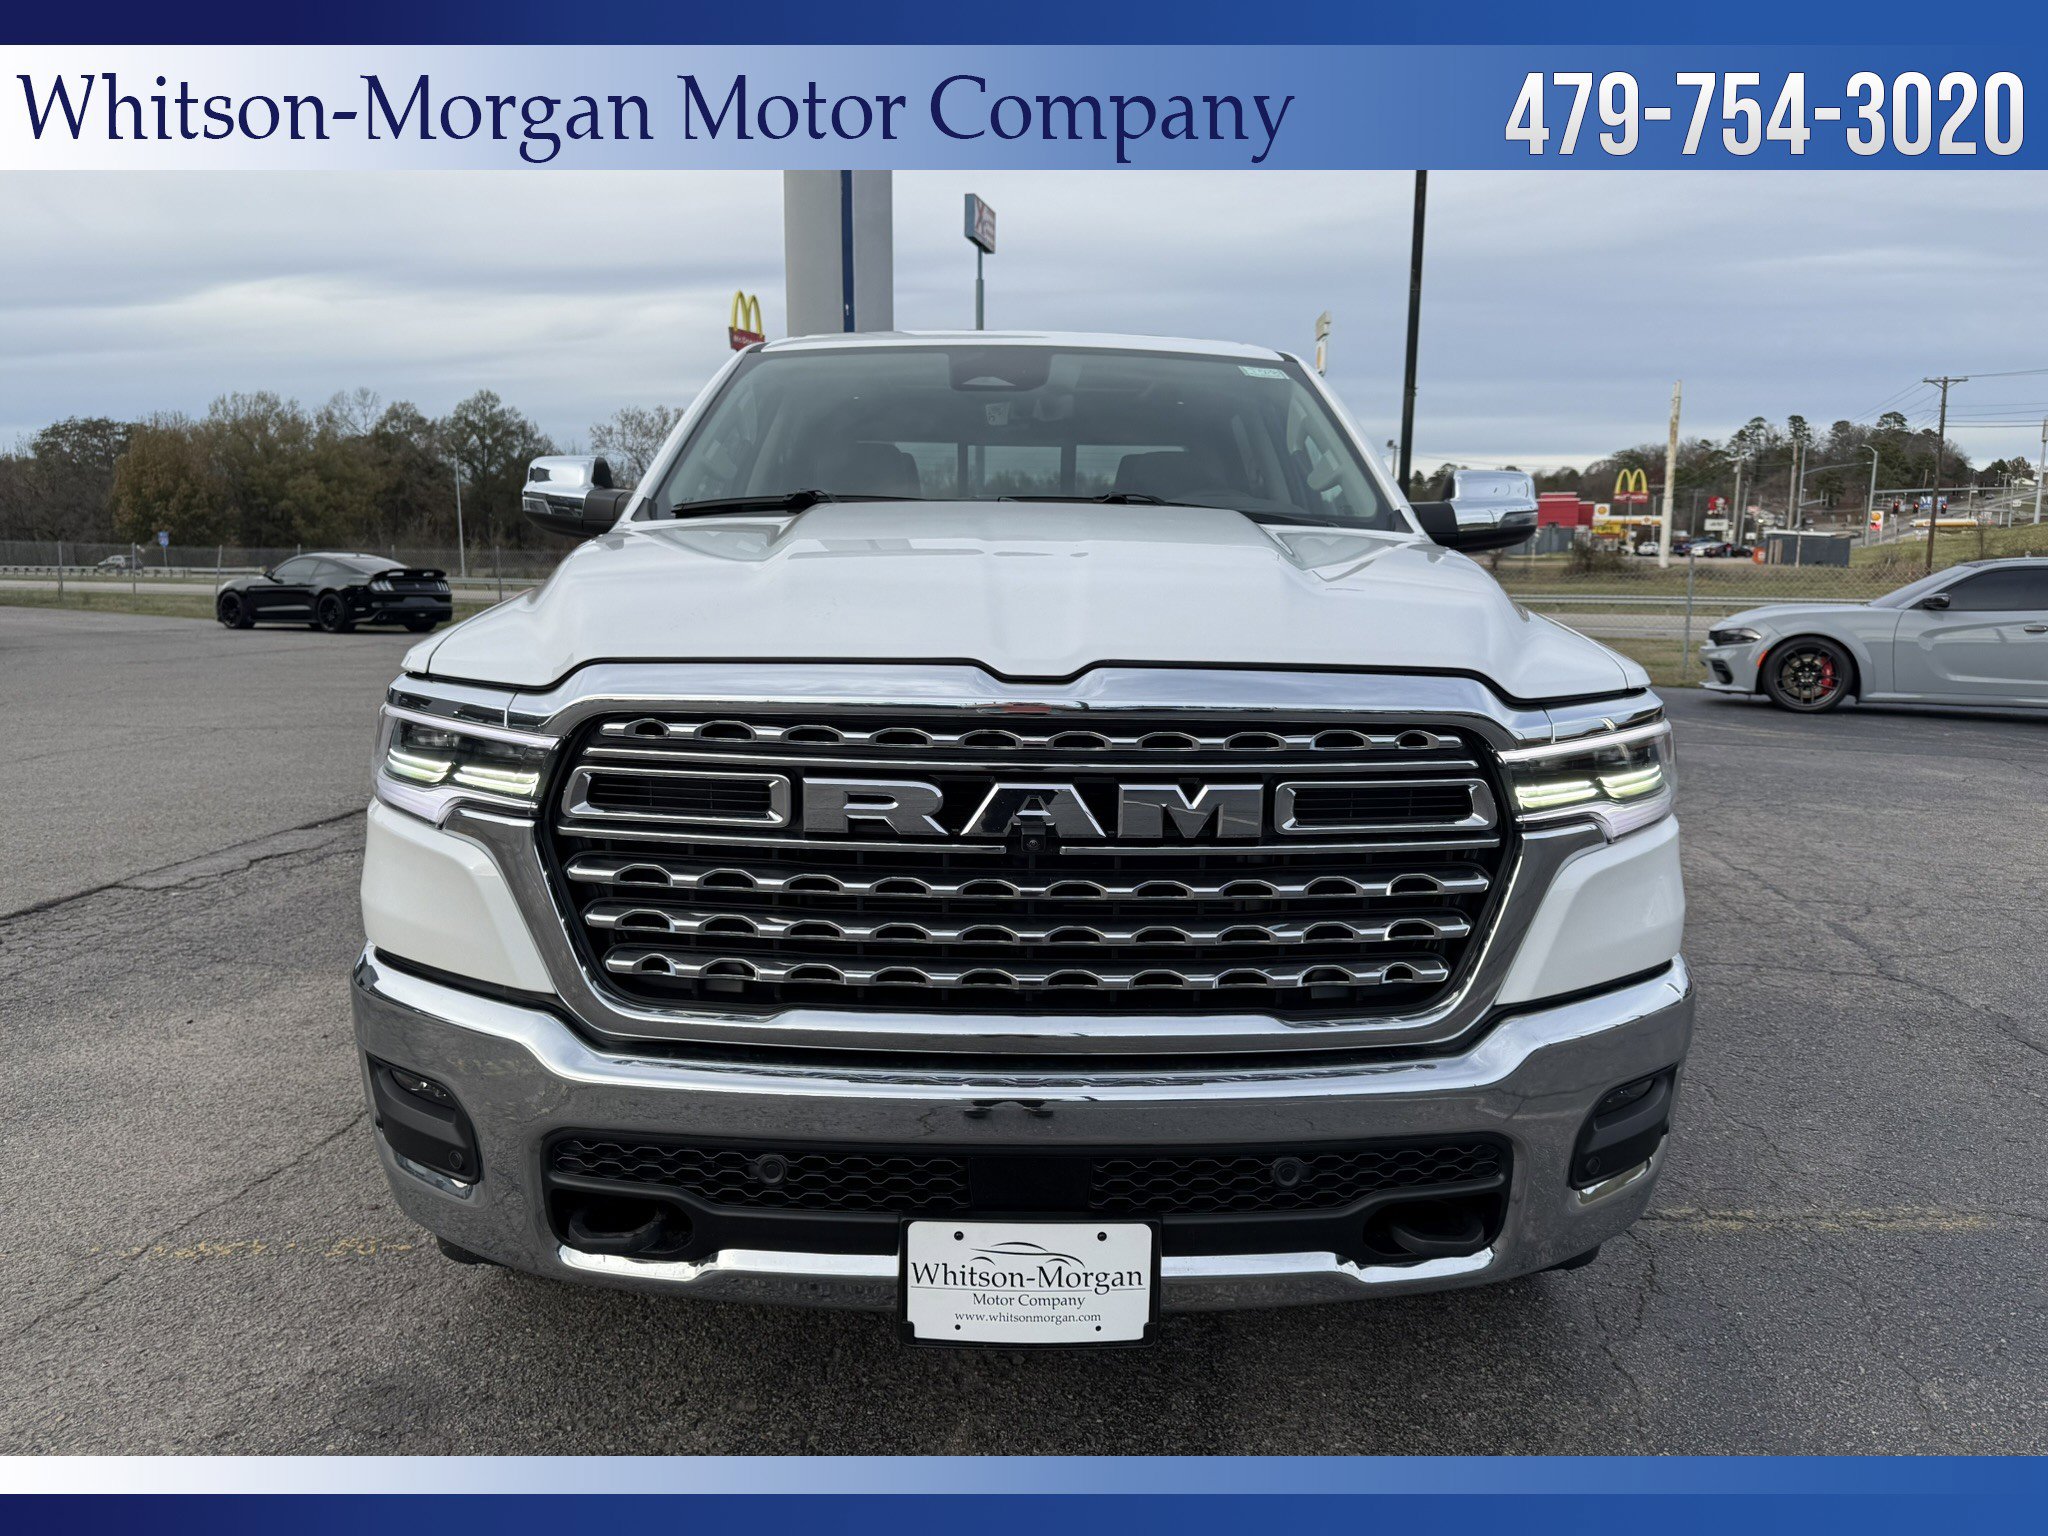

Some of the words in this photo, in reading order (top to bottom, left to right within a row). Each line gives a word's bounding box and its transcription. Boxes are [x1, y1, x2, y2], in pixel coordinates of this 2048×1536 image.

[802, 776, 1264, 840] RAM
[911, 1262, 1143, 1295] Whitson-Morgan
[973, 1293, 1015, 1306] Motor
[1018, 1293, 1086, 1310] Company
[954, 1311, 1102, 1326] www.whitsonmorgan.com
